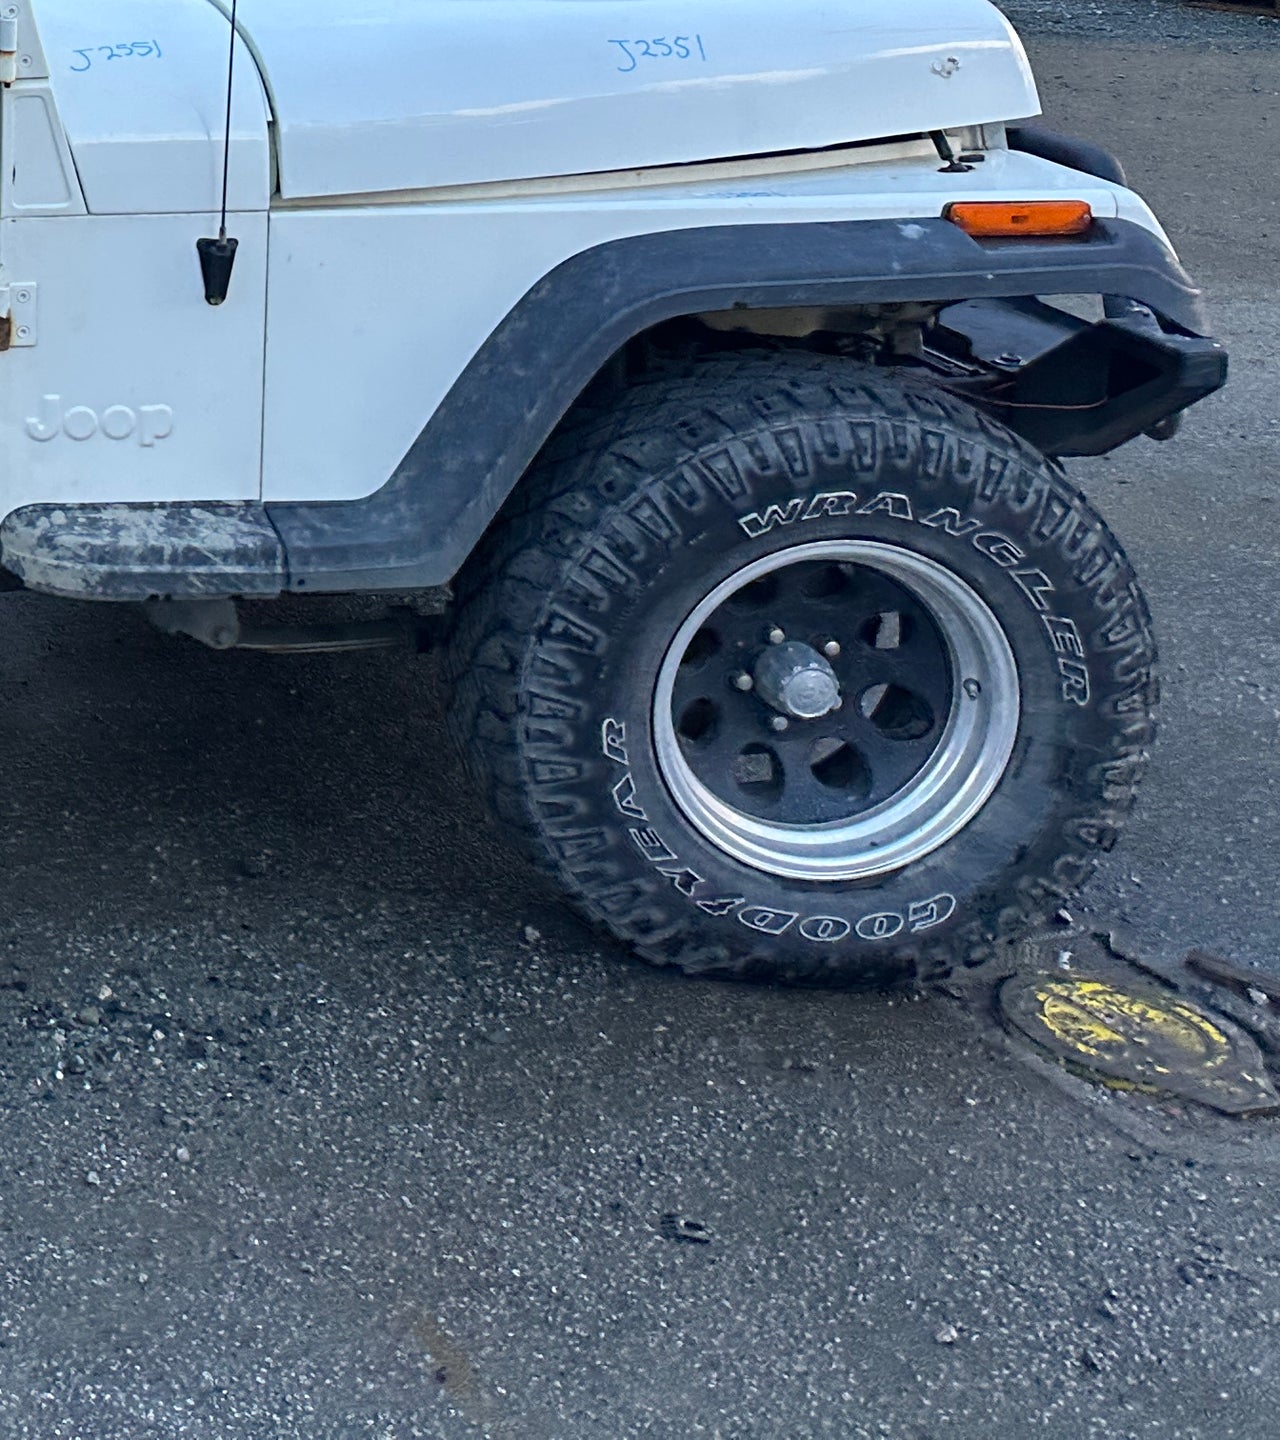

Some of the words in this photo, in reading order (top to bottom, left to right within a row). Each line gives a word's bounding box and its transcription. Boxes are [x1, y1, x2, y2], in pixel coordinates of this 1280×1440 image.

[70, 39, 162, 72] J2551
[607, 34, 706, 72] J2551
[738, 491, 1090, 707] WRANGLER
[602, 718, 957, 942] GOODYEAR
